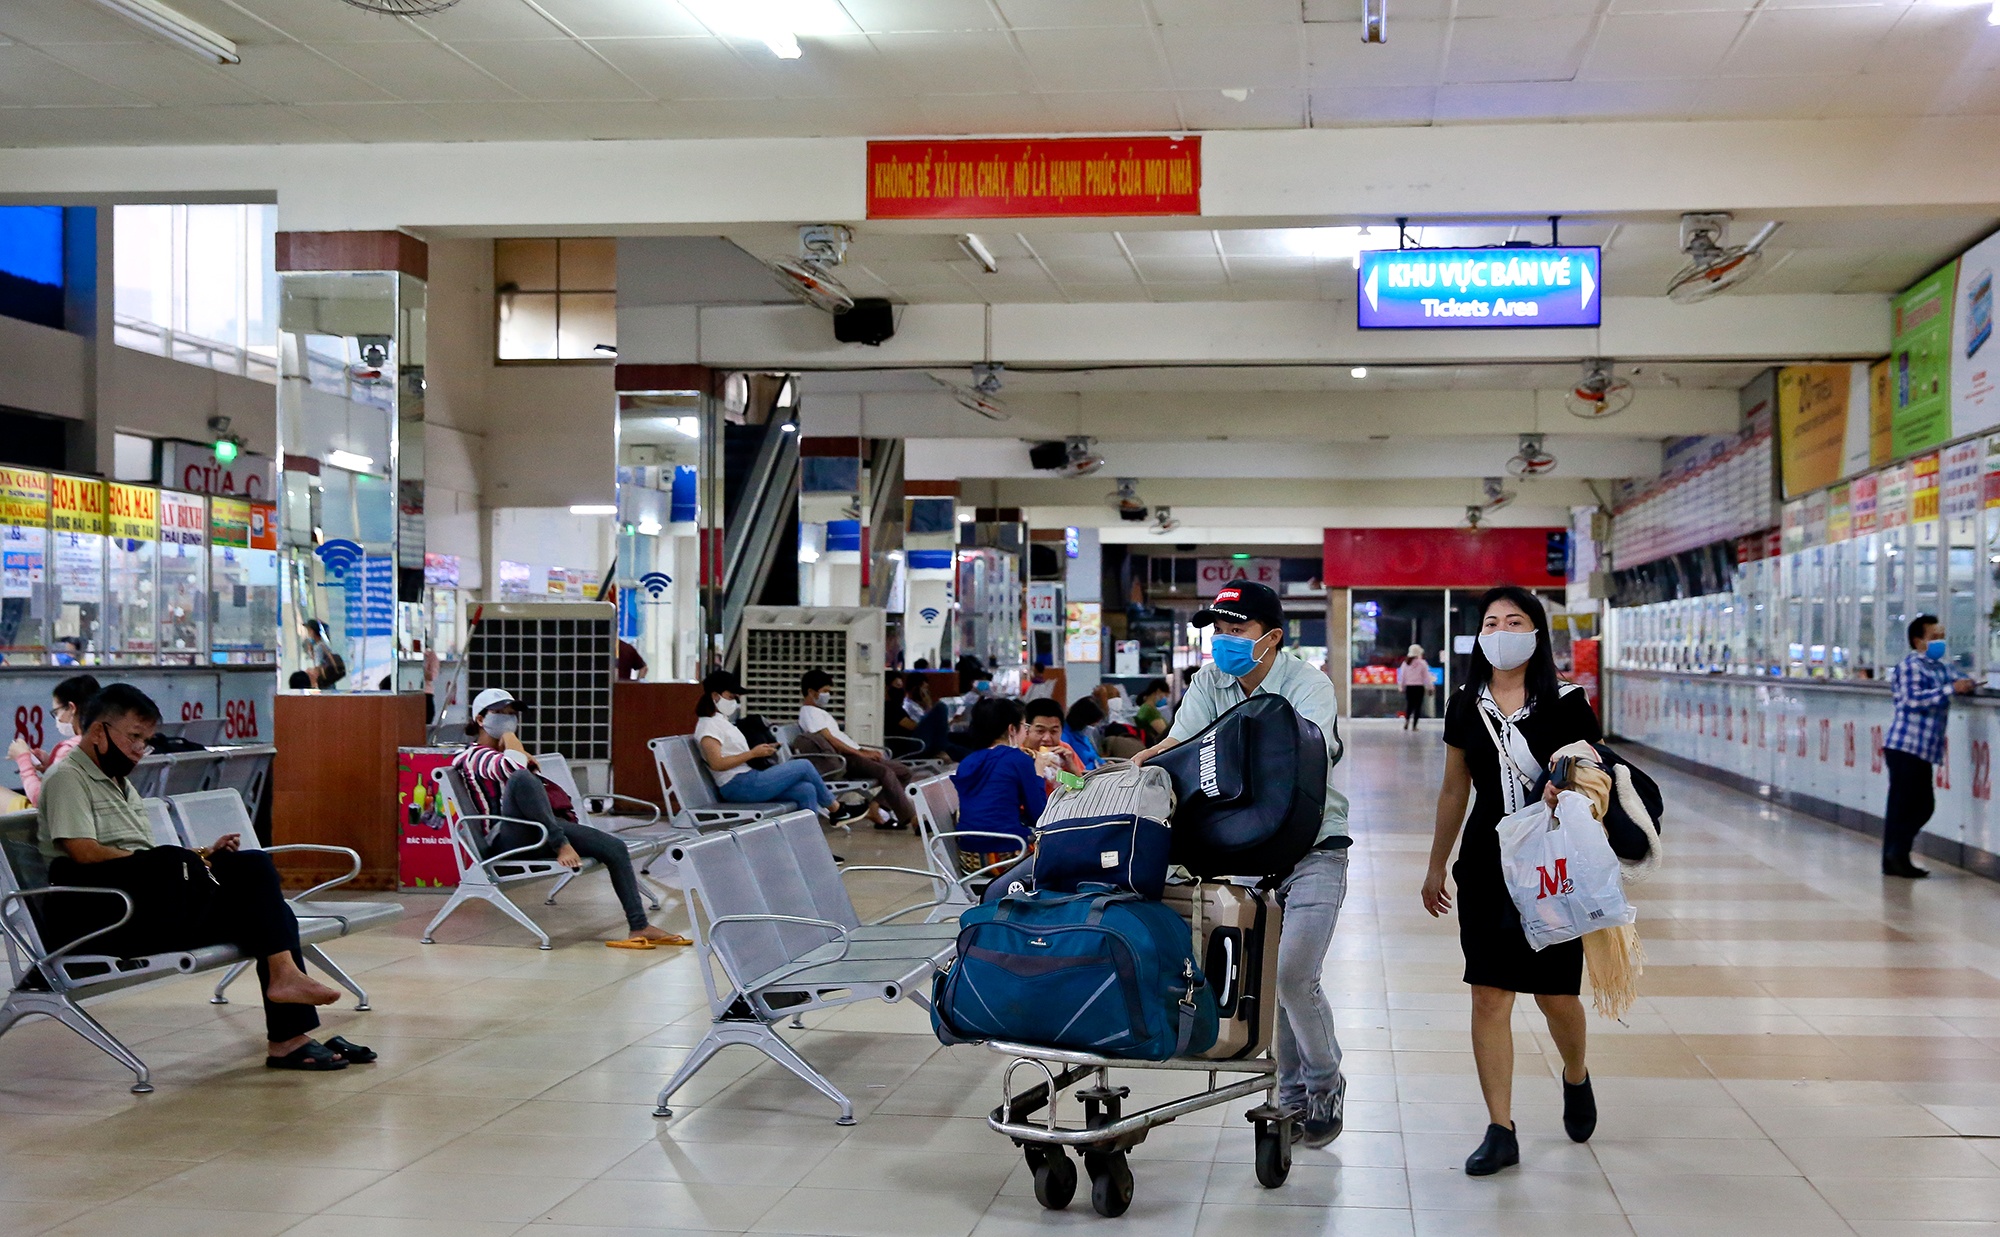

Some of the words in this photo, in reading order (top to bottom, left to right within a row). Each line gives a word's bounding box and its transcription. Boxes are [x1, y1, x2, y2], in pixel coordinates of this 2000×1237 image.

[875, 154, 913, 198] KHÔNG
[916, 147, 931, 198] ĐỂ
[959, 161, 975, 197] RA
[977, 153, 1009, 204] CHÁY,
[1032, 152, 1047, 196] LÀ
[1050, 160, 1081, 204] HẠNH
[1086, 151, 1116, 196] PHÚC
[1119, 146, 1142, 196] CỦA
[1145, 158, 1167, 202] MỌI
[1388, 262, 1437, 288] KHU
[1438, 258, 1487, 294] VỰC
[1490, 256, 1538, 287] BÁN
[1540, 256, 1571, 286] VÉ
[1420, 297, 1490, 318] Tickets
[1492, 298, 1538, 318] Area
[183, 456, 234, 494] CỬA
[52, 478, 77, 511] HOA
[80, 482, 102, 514] MAI
[109, 485, 131, 517] HOA
[134, 490, 153, 519] MAI
[1202, 560, 1248, 581] CỬA
[1257, 566, 1272, 582] E
[14, 705, 43, 749] 83
[225, 700, 259, 739] 86A
